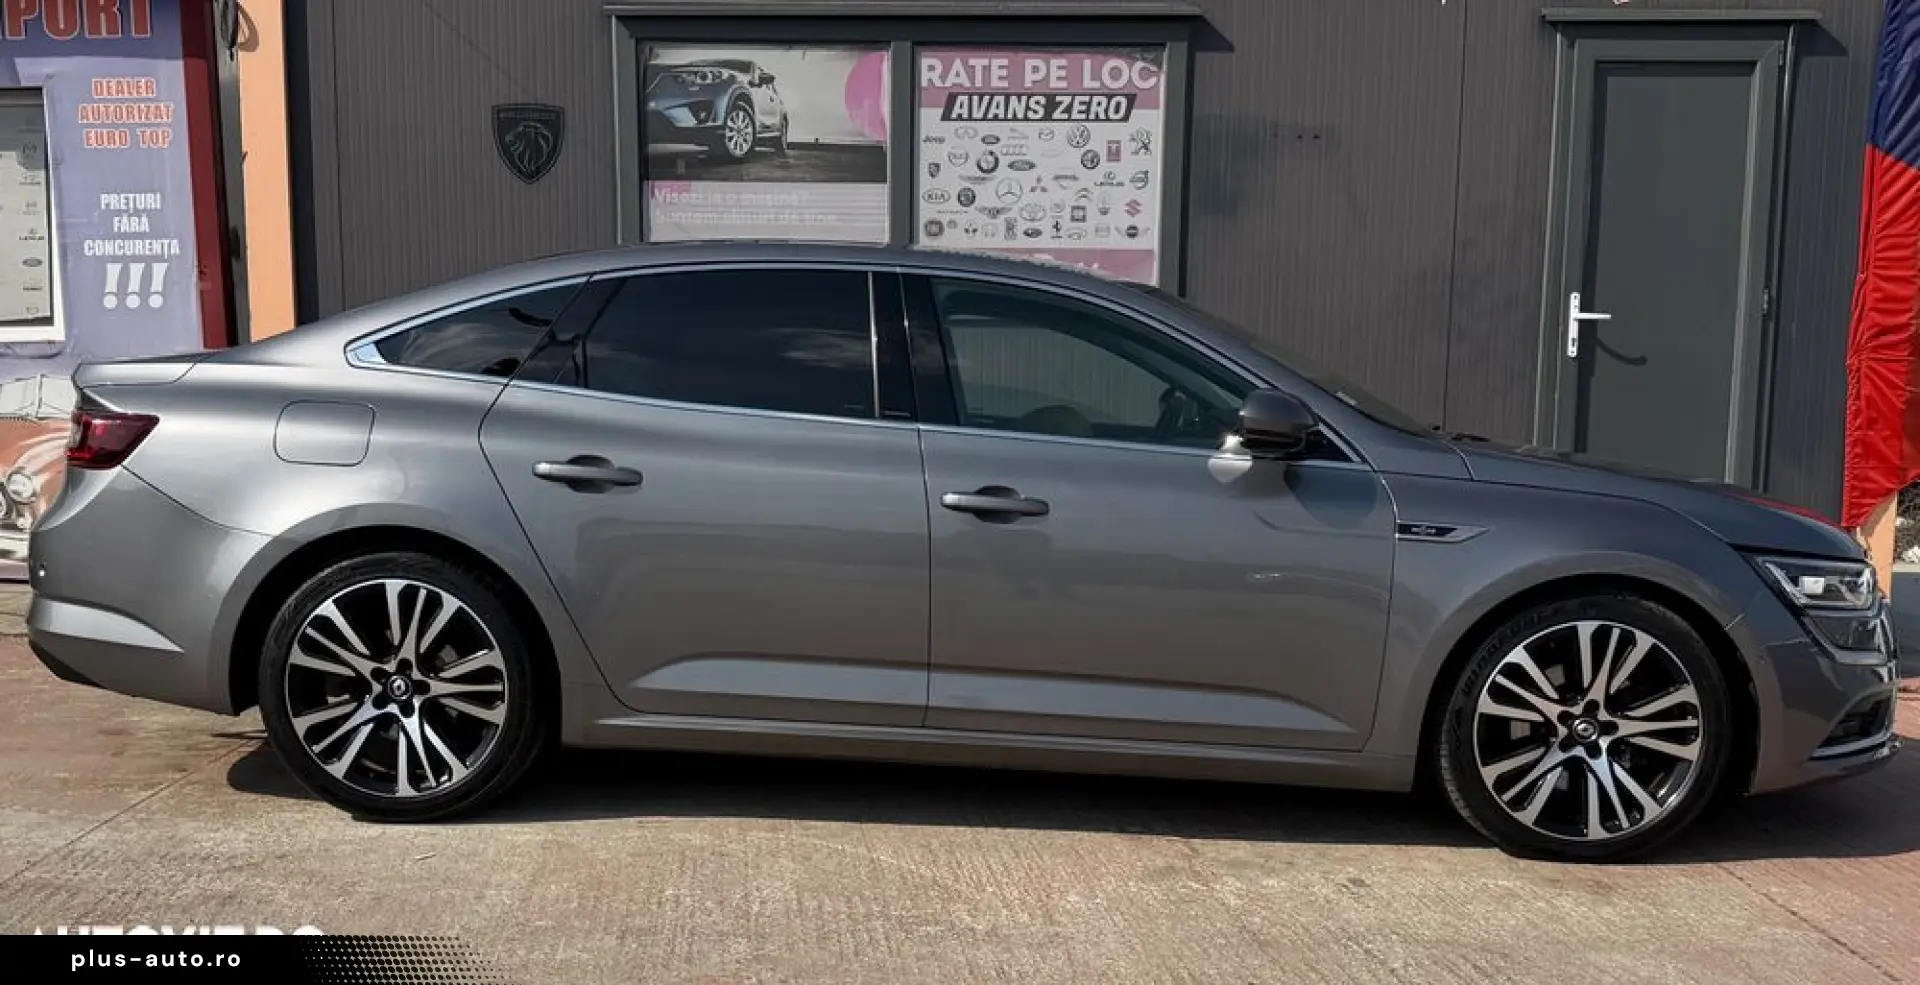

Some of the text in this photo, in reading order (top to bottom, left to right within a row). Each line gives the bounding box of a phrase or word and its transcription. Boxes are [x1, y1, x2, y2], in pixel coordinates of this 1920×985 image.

[0, 0, 151, 39] PORT
[920, 57, 1161, 90] RATE PE LOC
[92, 78, 156, 98] DEALER
[79, 102, 174, 124] AUTORIZAT
[951, 95, 1129, 120] AVANS ZERO
[83, 128, 172, 148] EURO TOP
